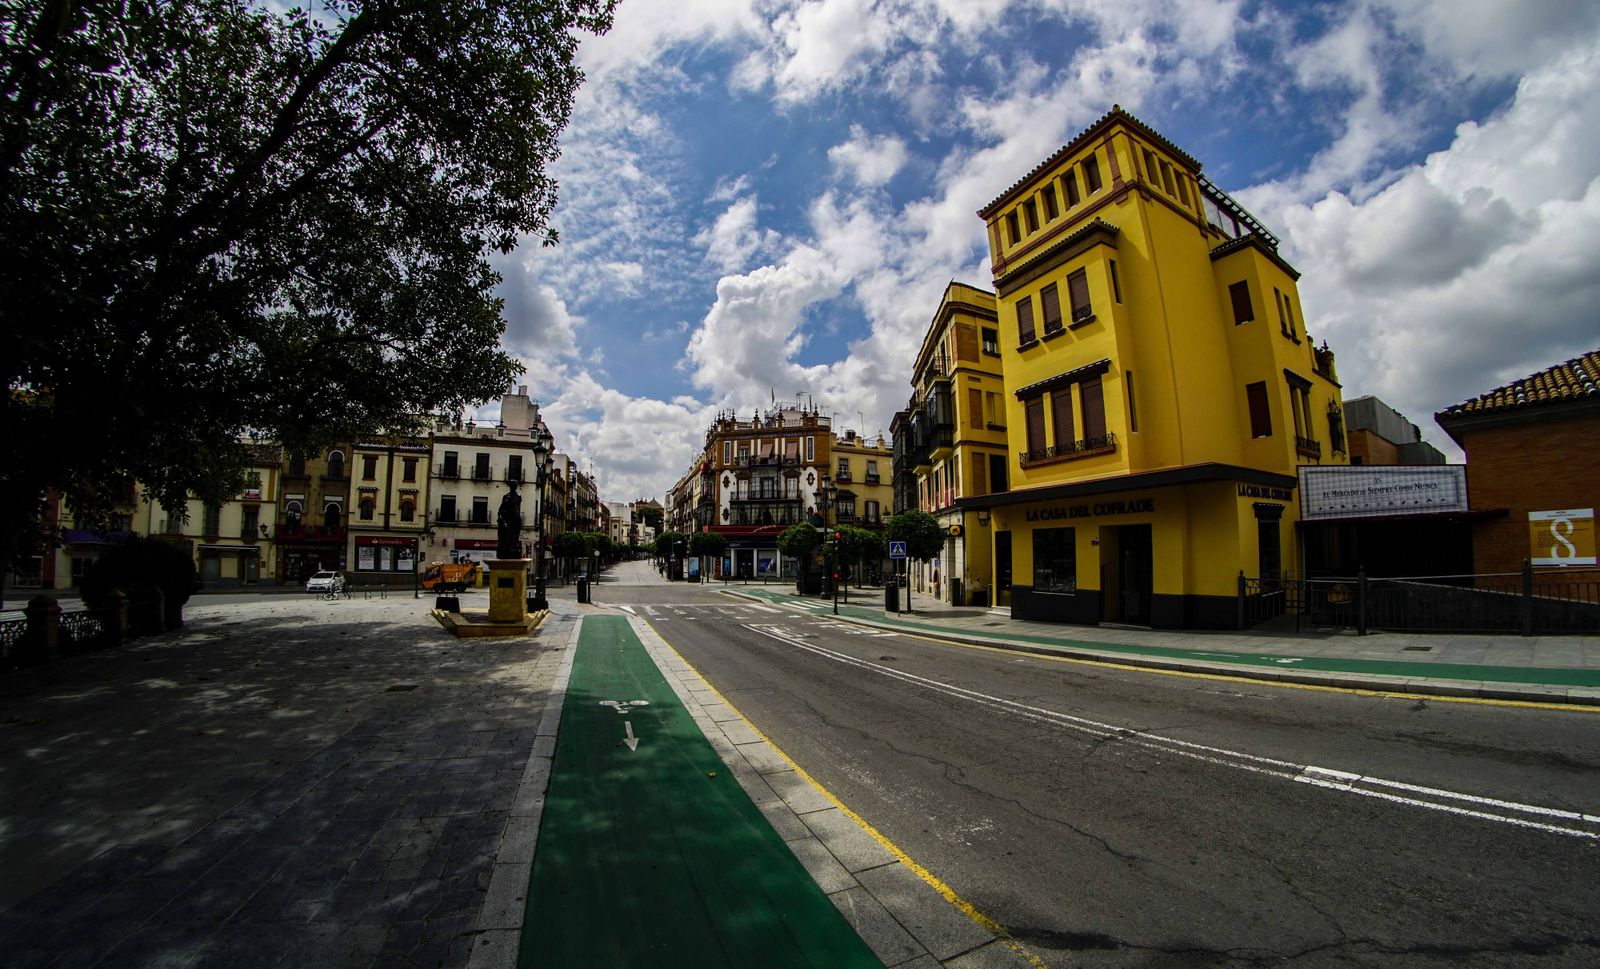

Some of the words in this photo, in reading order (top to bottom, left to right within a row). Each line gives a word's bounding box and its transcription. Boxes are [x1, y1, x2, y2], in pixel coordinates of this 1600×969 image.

[1237, 484, 1246, 497] LA
[1246, 485, 1260, 498] CASA
[1414, 482, 1438, 490] NUNCA
[1026, 509, 1039, 521] LA
[1040, 507, 1067, 520] CASA
[1069, 505, 1091, 518] DEL
[1094, 499, 1154, 516] COFRADE
